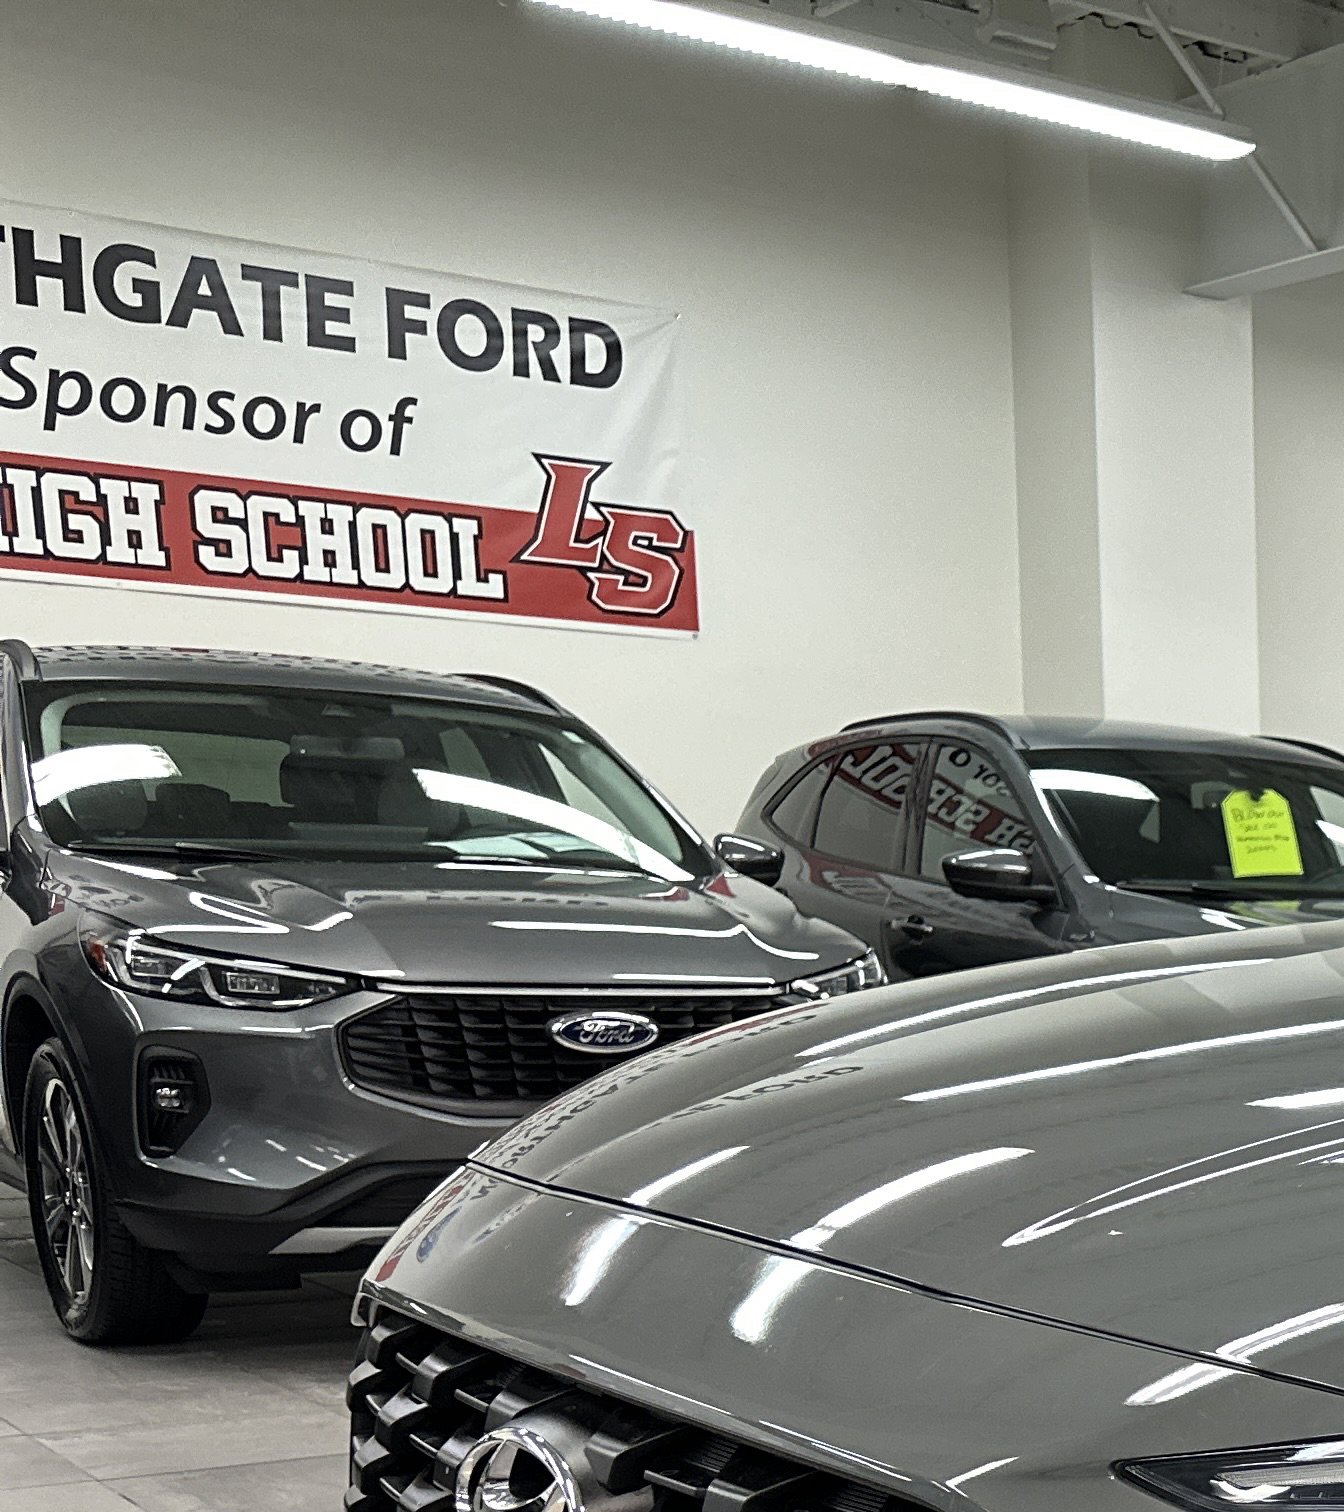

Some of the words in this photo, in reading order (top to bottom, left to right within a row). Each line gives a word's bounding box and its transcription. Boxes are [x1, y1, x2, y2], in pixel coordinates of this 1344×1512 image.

[0, 225, 356, 353] HGATE
[386, 287, 624, 390] FORD
[0, 345, 321, 445] Sponsor
[340, 396, 418, 456] of
[0, 462, 171, 570] IGH
[191, 484, 508, 602] SCHOOL
[509, 452, 694, 617] LS
[577, 1020, 635, 1043] Ford
